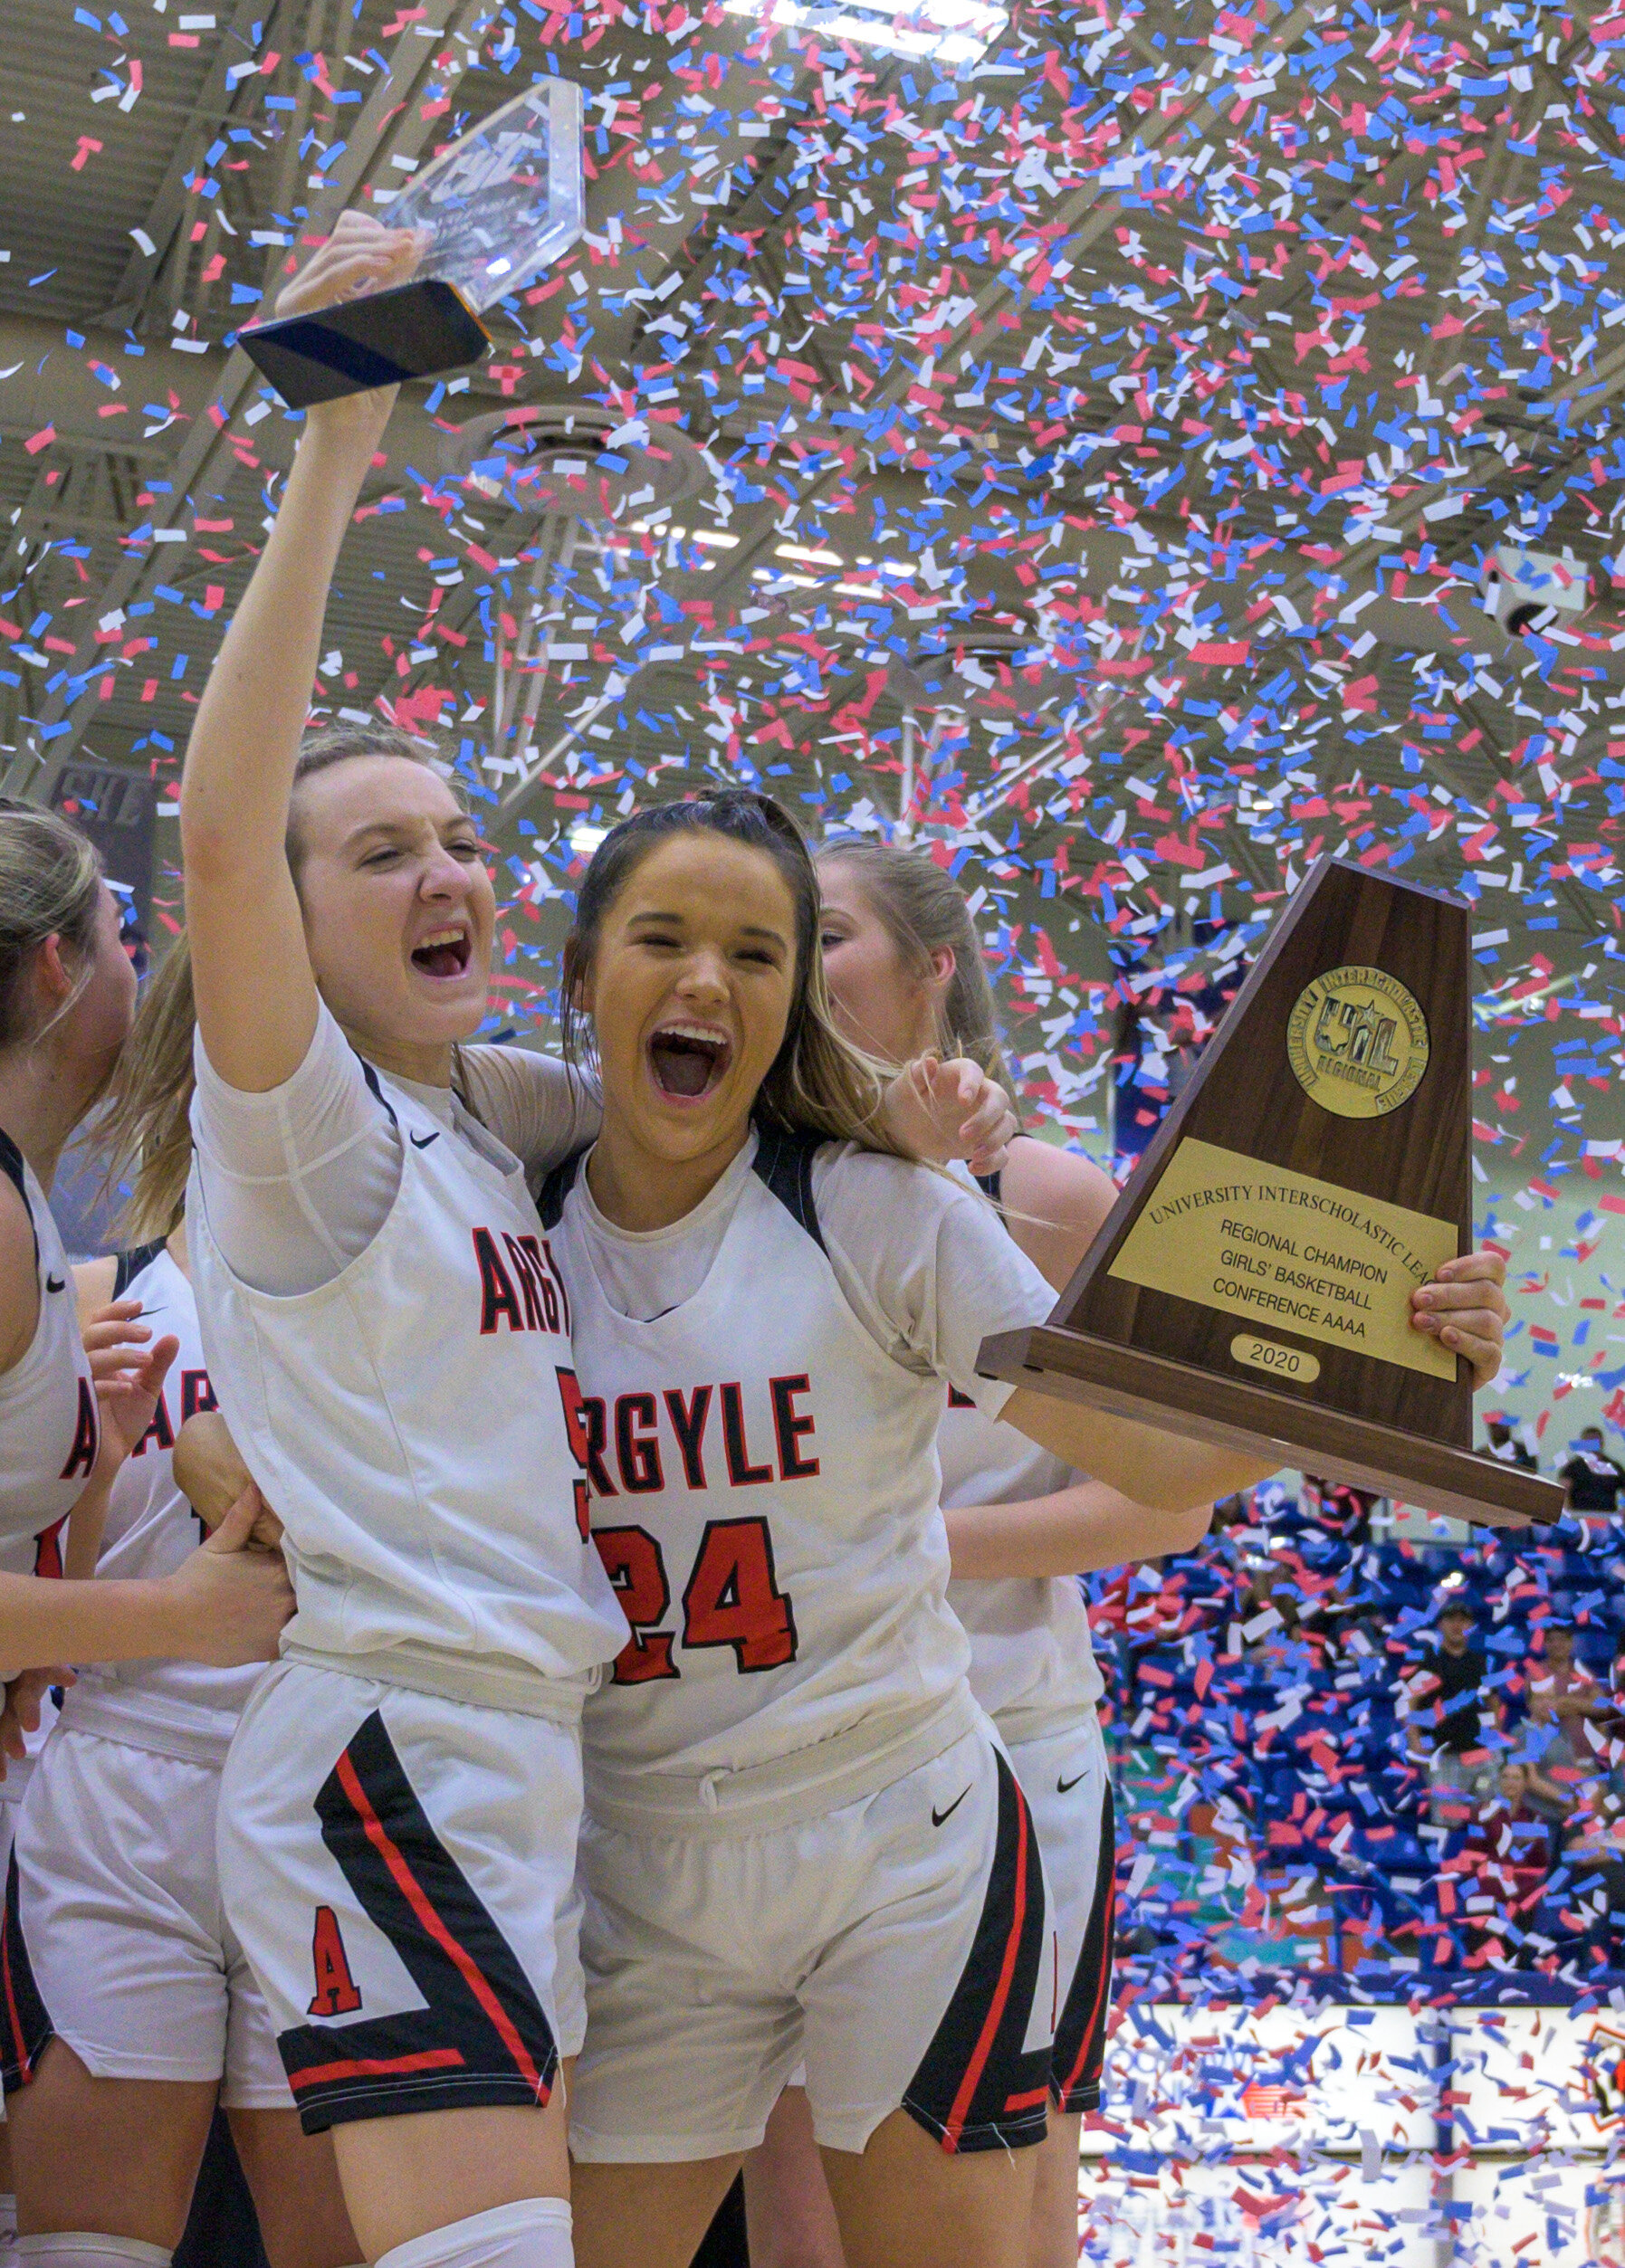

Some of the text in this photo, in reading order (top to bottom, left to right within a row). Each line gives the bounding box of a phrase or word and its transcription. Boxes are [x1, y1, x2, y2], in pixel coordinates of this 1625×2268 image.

[1315, 1054, 1381, 1092] REGIONAL
[1149, 1185, 1254, 1225] UNIVERSITY
[1258, 1185, 1405, 1257] INTERSCHOLASTIC
[1220, 1218, 1389, 1285] REGIONAL CHAMPION
[1212, 1277, 1366, 1339] CONFERENCE AAAA
[1220, 1249, 1372, 1310] GIRLS' BASKETBALL
[1249, 1343, 1300, 1373] 2020
[590, 1514, 799, 1686] 24
[306, 1904, 362, 2017] A
